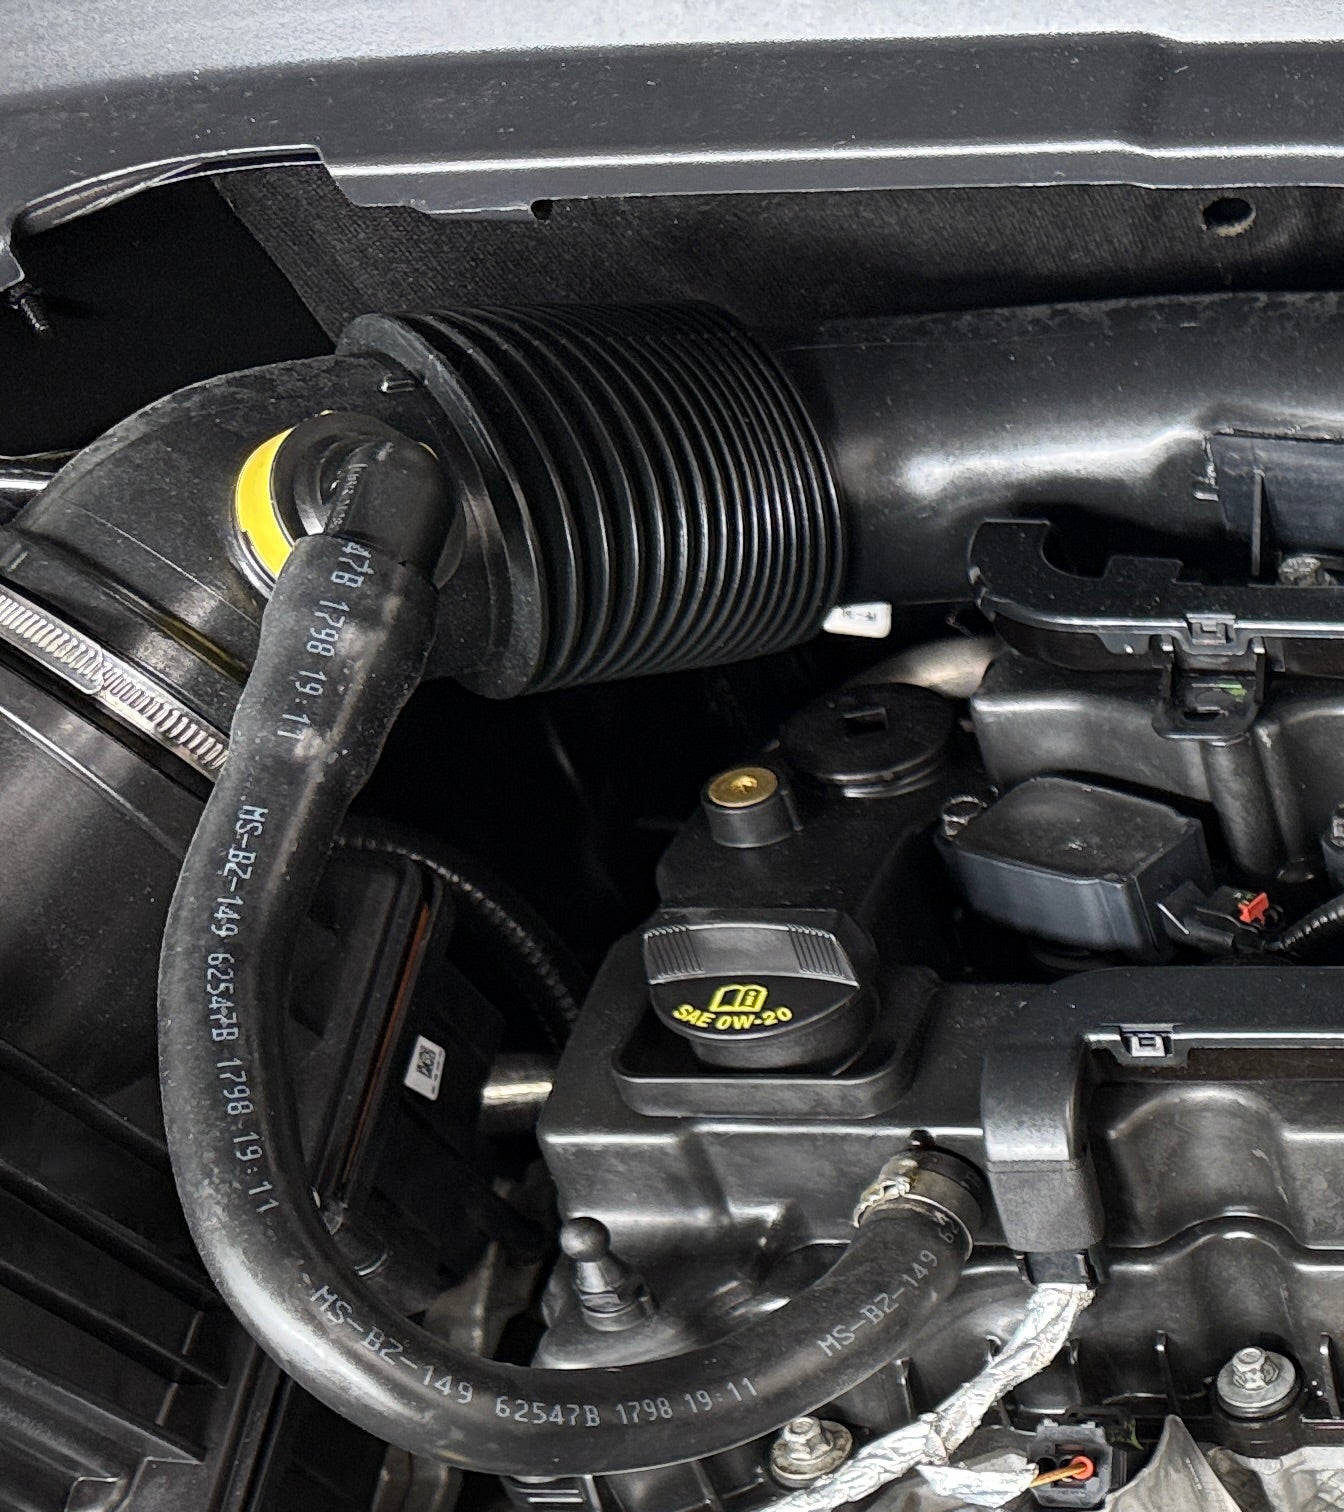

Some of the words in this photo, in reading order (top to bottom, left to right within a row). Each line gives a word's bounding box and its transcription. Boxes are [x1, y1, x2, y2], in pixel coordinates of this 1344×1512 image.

[306, 599, 350, 657] 1798
[277, 670, 328, 740] 19:11
[206, 952, 240, 1043] 62547B
[672, 1003, 717, 1029] SAE
[715, 1005, 793, 1031] 0W-20
[216, 1057, 255, 1116] 1798
[232, 1131, 281, 1214] 19:11
[495, 1396, 600, 1428] 62547B
[615, 1397, 673, 1425] 1798
[684, 1377, 758, 1413] 19:11
